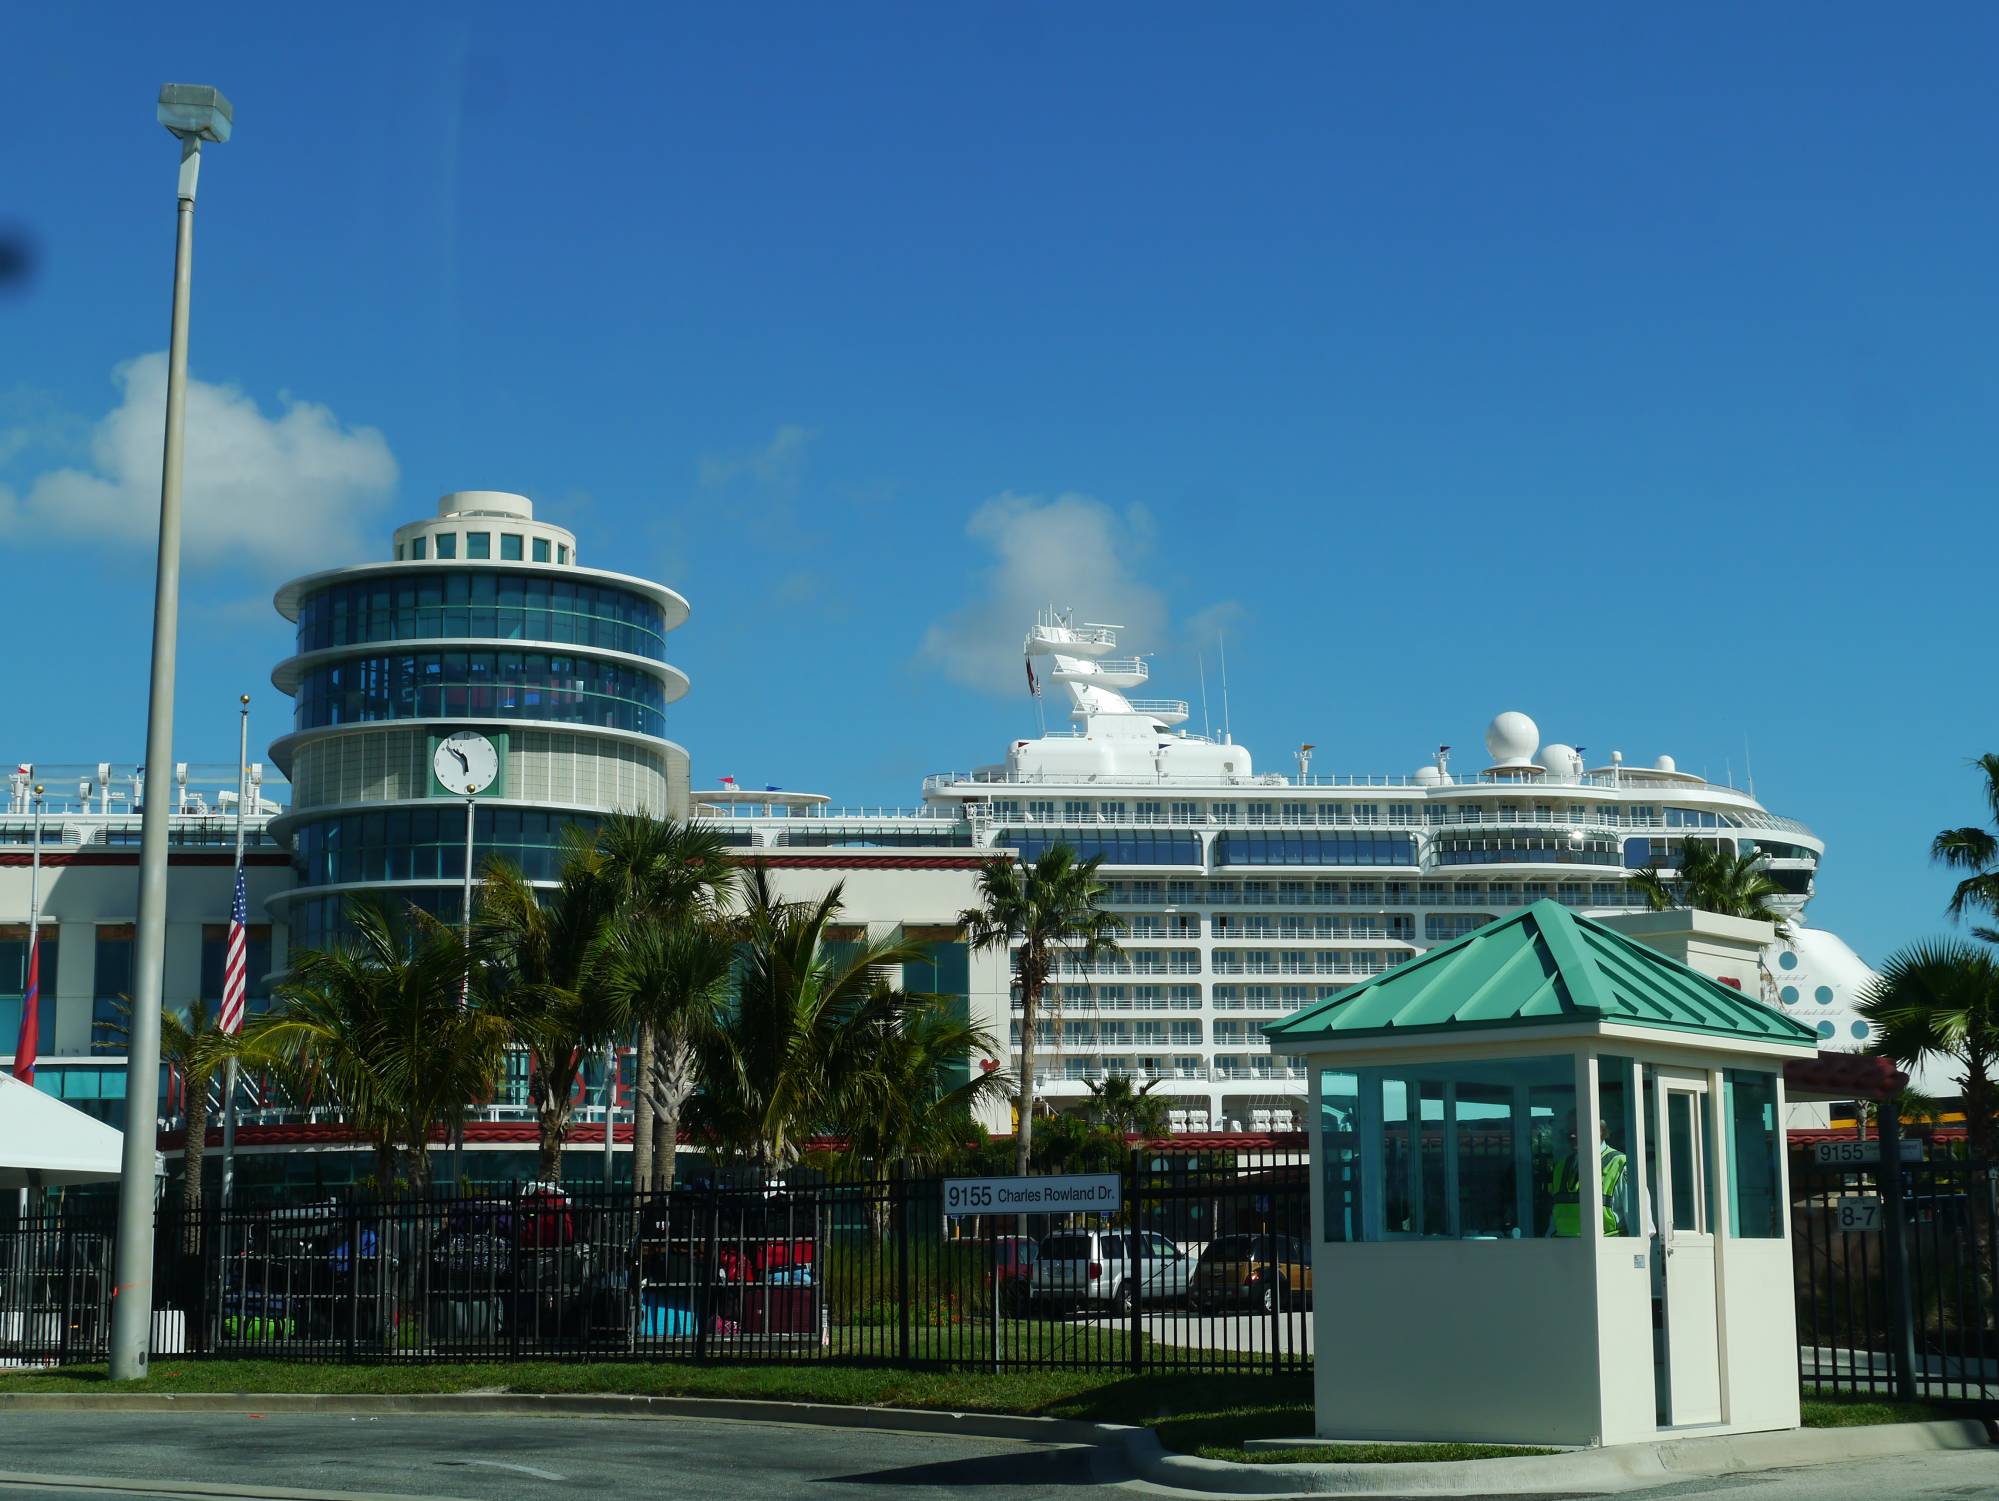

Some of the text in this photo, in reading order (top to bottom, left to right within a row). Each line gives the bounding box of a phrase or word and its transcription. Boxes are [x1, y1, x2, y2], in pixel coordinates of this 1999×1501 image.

[1820, 1144, 1864, 1161] 9155
[949, 1185, 1116, 1207] 9155 Charles Rowland Dr.
[1842, 1207, 1876, 1226] 8-7
